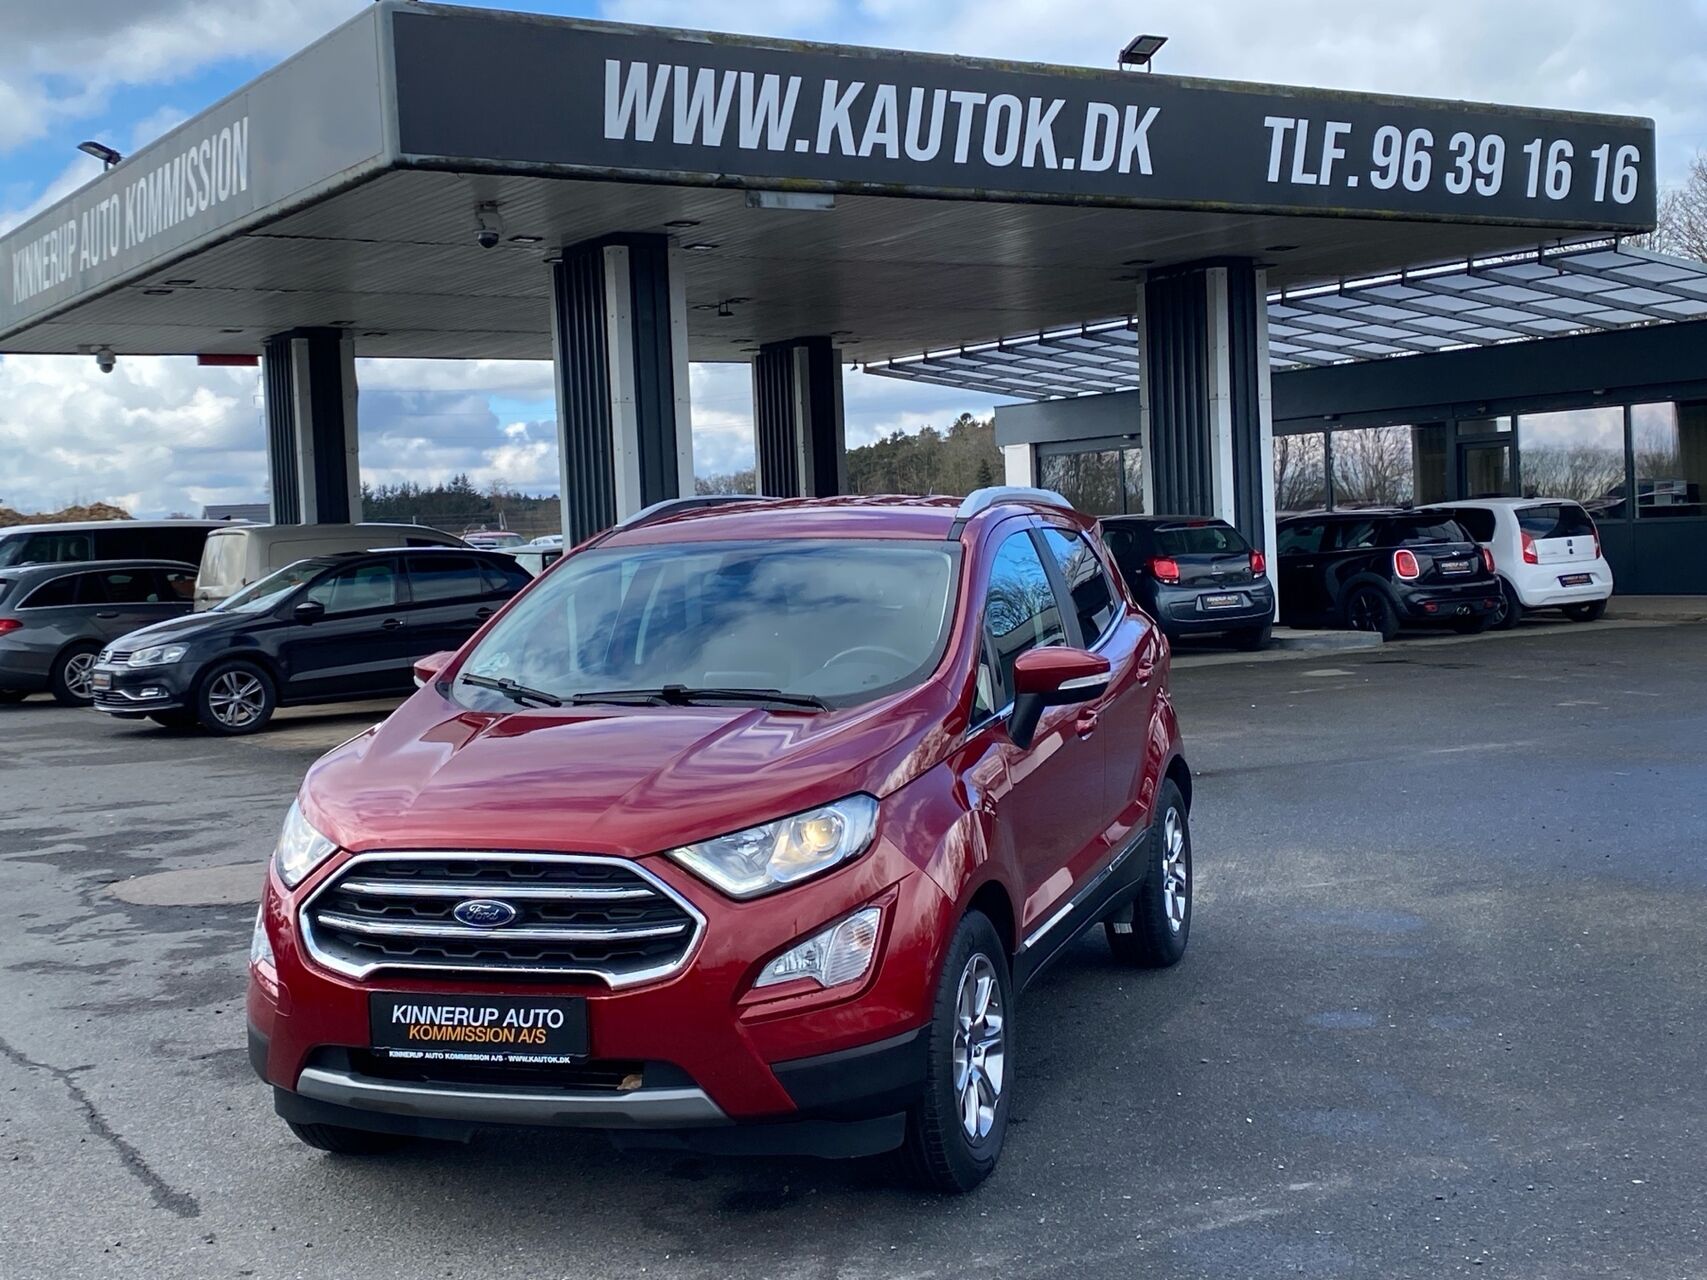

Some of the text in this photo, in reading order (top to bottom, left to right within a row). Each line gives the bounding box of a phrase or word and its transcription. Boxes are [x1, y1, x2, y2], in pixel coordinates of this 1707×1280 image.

[604, 59, 1161, 175] WWW.KAUTOK.DK
[1264, 116, 1641, 204] TLF. 96 39 16 16
[12, 116, 249, 305] KINNERUP AUTO KOMMISSION
[466, 904, 500, 920] Ford
[392, 1005, 564, 1028] KINNERUP AUTO
[409, 1025, 547, 1044] KOMMISSION A/S
